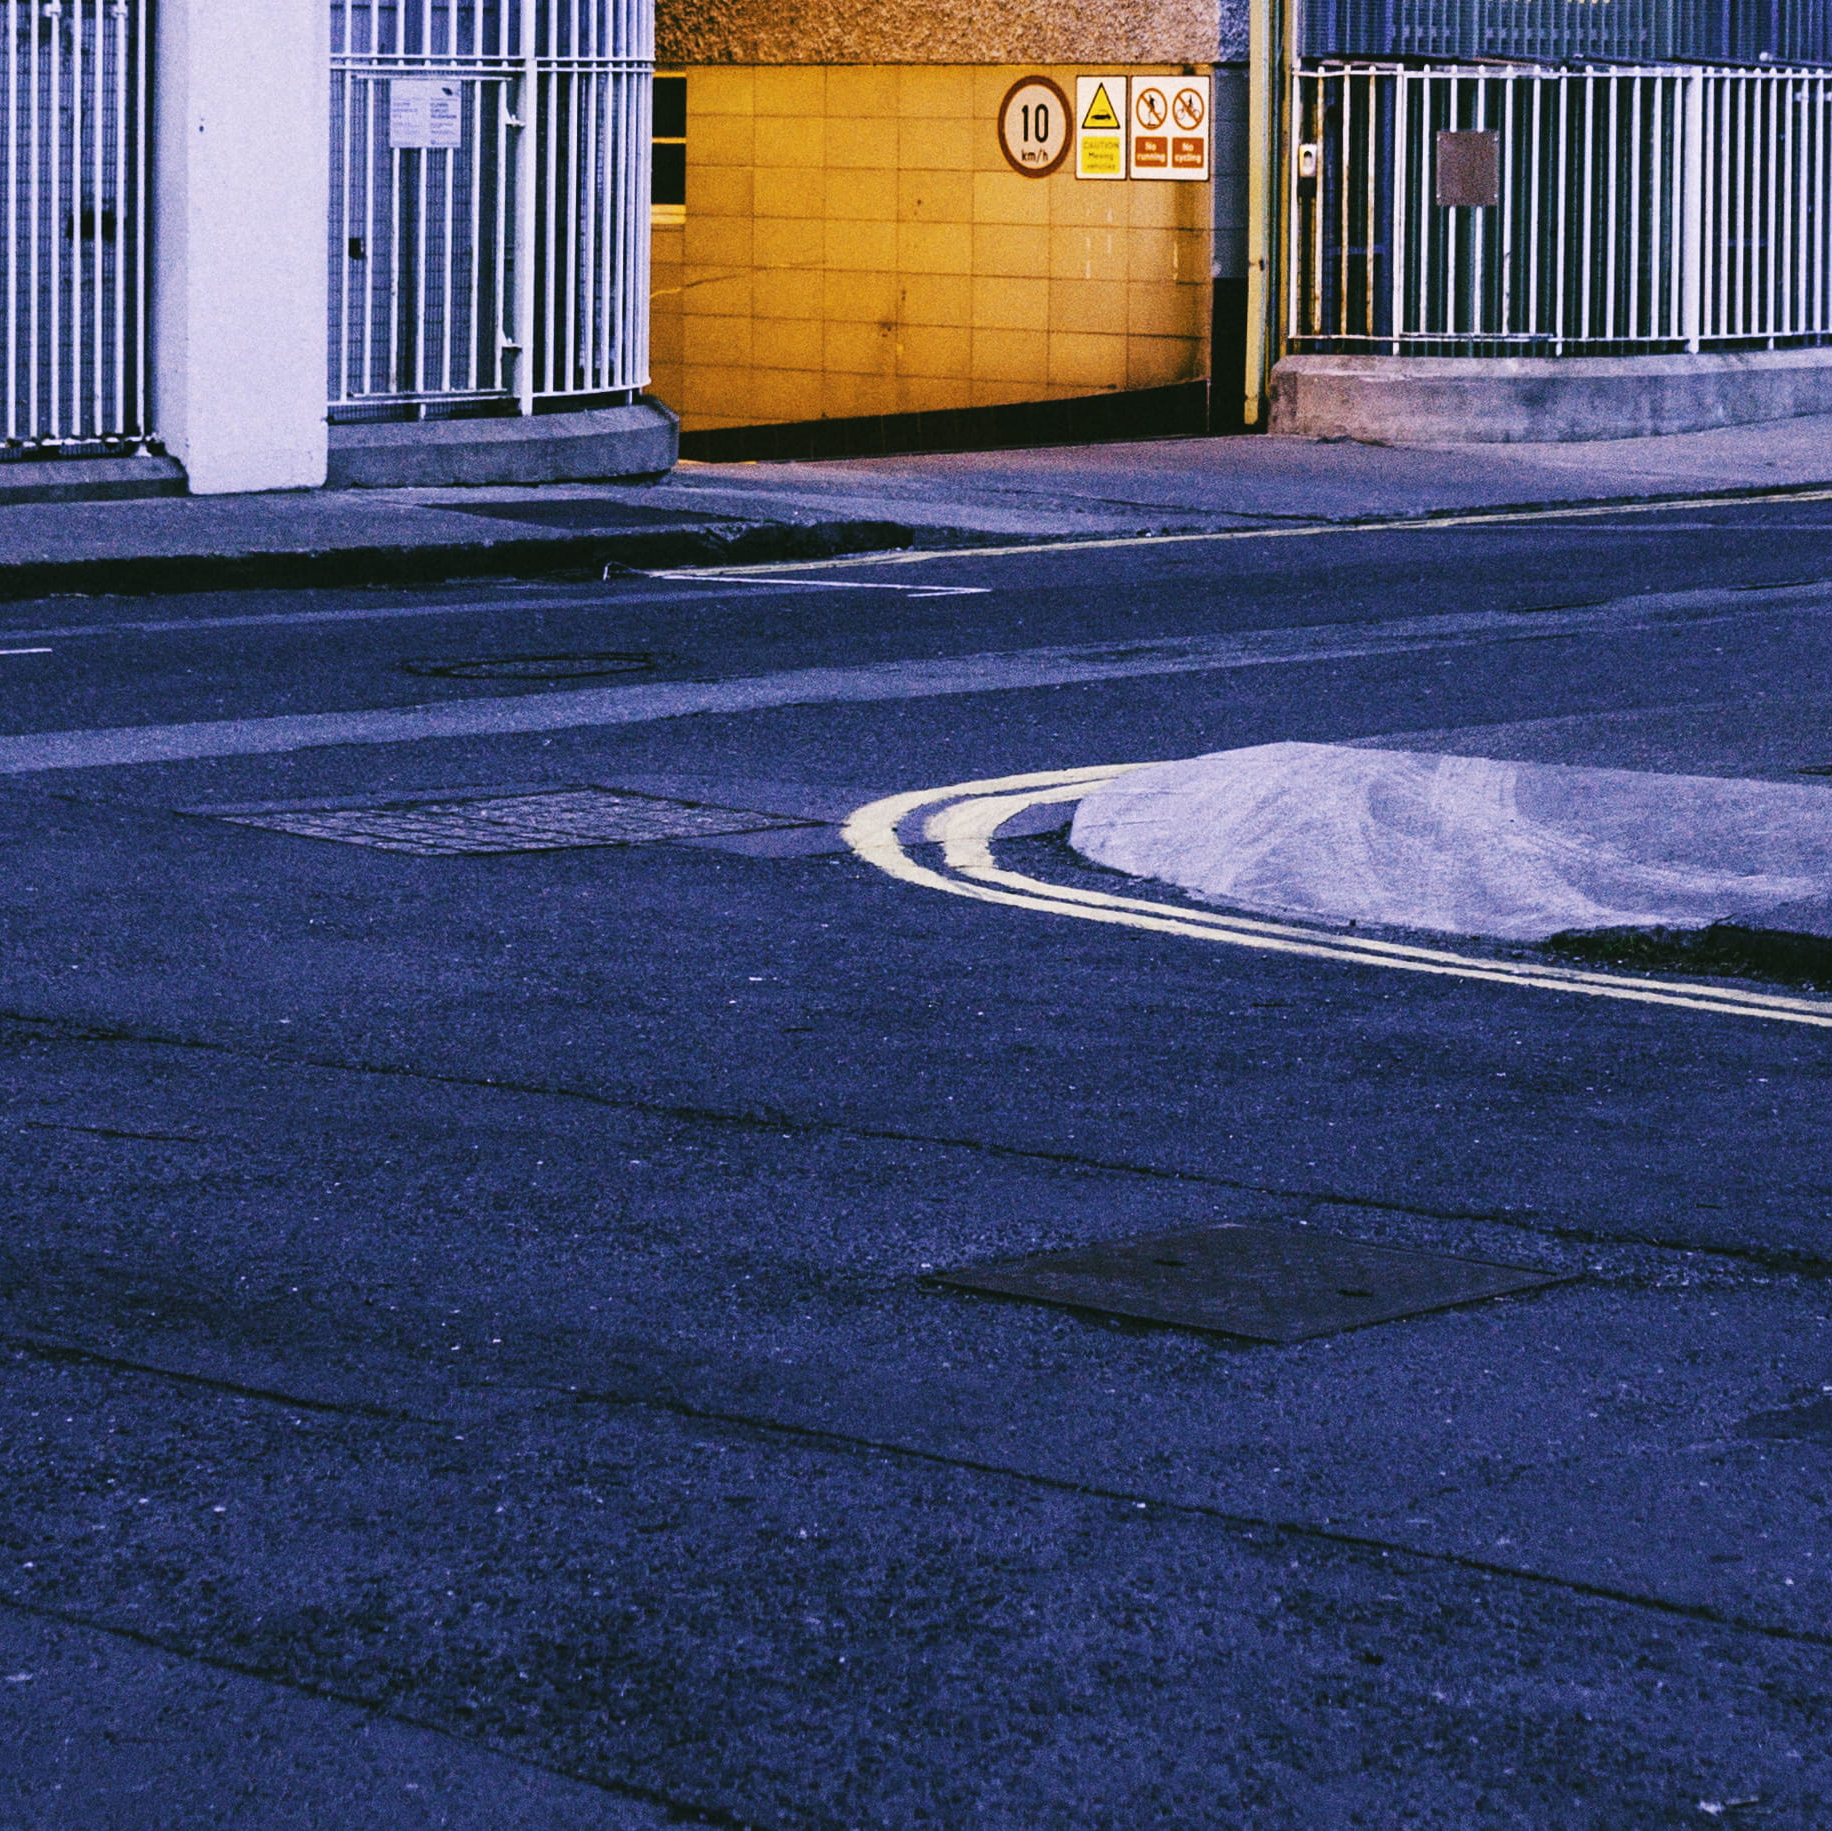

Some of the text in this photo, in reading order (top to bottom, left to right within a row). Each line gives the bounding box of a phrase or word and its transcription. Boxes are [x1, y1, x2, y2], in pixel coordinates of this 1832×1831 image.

[1021, 103, 1049, 143] 10
[1145, 142, 1157, 151] No
[1182, 142, 1194, 151] No
[1021, 148, 1049, 162] km/h
[1137, 153, 1166, 163] running
[1174, 153, 1201, 164] cycling
